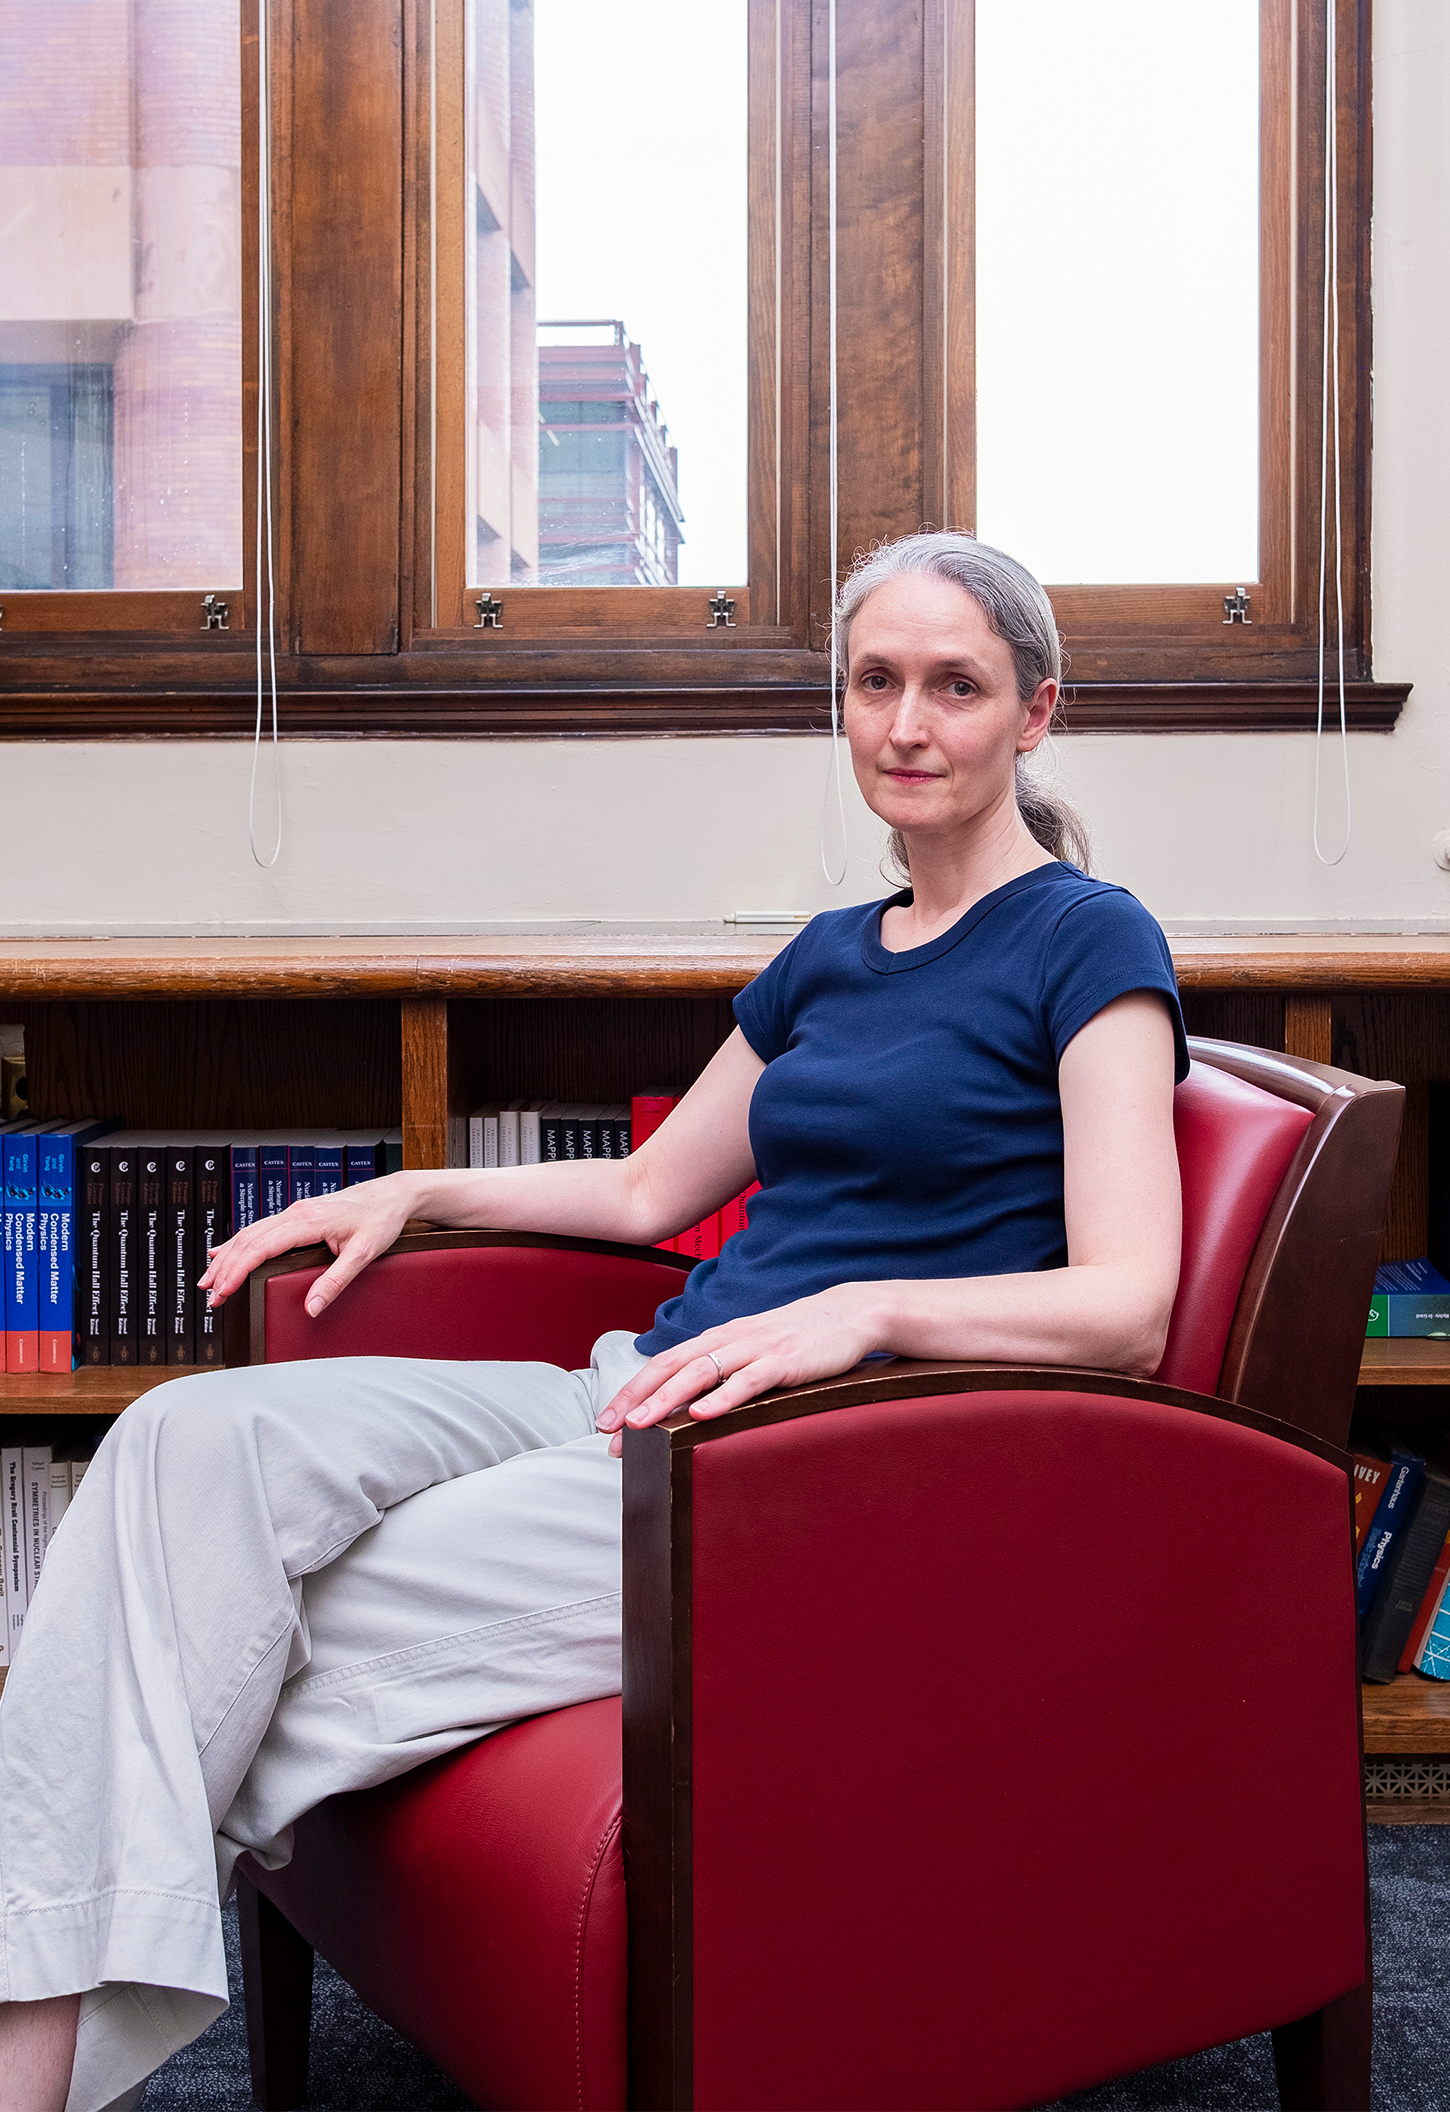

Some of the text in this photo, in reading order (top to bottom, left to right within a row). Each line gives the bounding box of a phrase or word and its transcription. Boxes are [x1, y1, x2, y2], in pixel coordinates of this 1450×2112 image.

[565, 1130, 575, 1159] MAPP
[583, 1130, 592, 1159] MAPP
[602, 1130, 611, 1159] MAPP
[238, 1188, 247, 1212] Simple
[267, 1186, 275, 1209] Simple
[4, 1213, 13, 1251] Physics
[26, 1213, 35, 1251] Modern
[39, 1213, 49, 1251] Physics
[61, 1213, 71, 1251] Modern
[206, 1209, 215, 1226] The
[15, 1213, 24, 1304] Condensed Matter
[50, 1213, 60, 1304] Condensed Matter
[90, 1211, 100, 1315] The Quantum Hall Effect
[118, 1210, 129, 1315] The Quantum Hall Effect
[146, 1211, 157, 1315] The Quantum Hall Effect
[175, 1209, 185, 1314] The Quantum Hall Effect
[9, 1475, 17, 1500] Gregory
[31, 1481, 40, 1527] SYMMETRIES
[11, 1519, 19, 1554] Centennial
[33, 1528, 40, 1536] IN
[1371, 1531, 1393, 1570] Physics
[33, 1537, 41, 1570] NUCLEAR
[12, 1554, 20, 1592] Symposium
